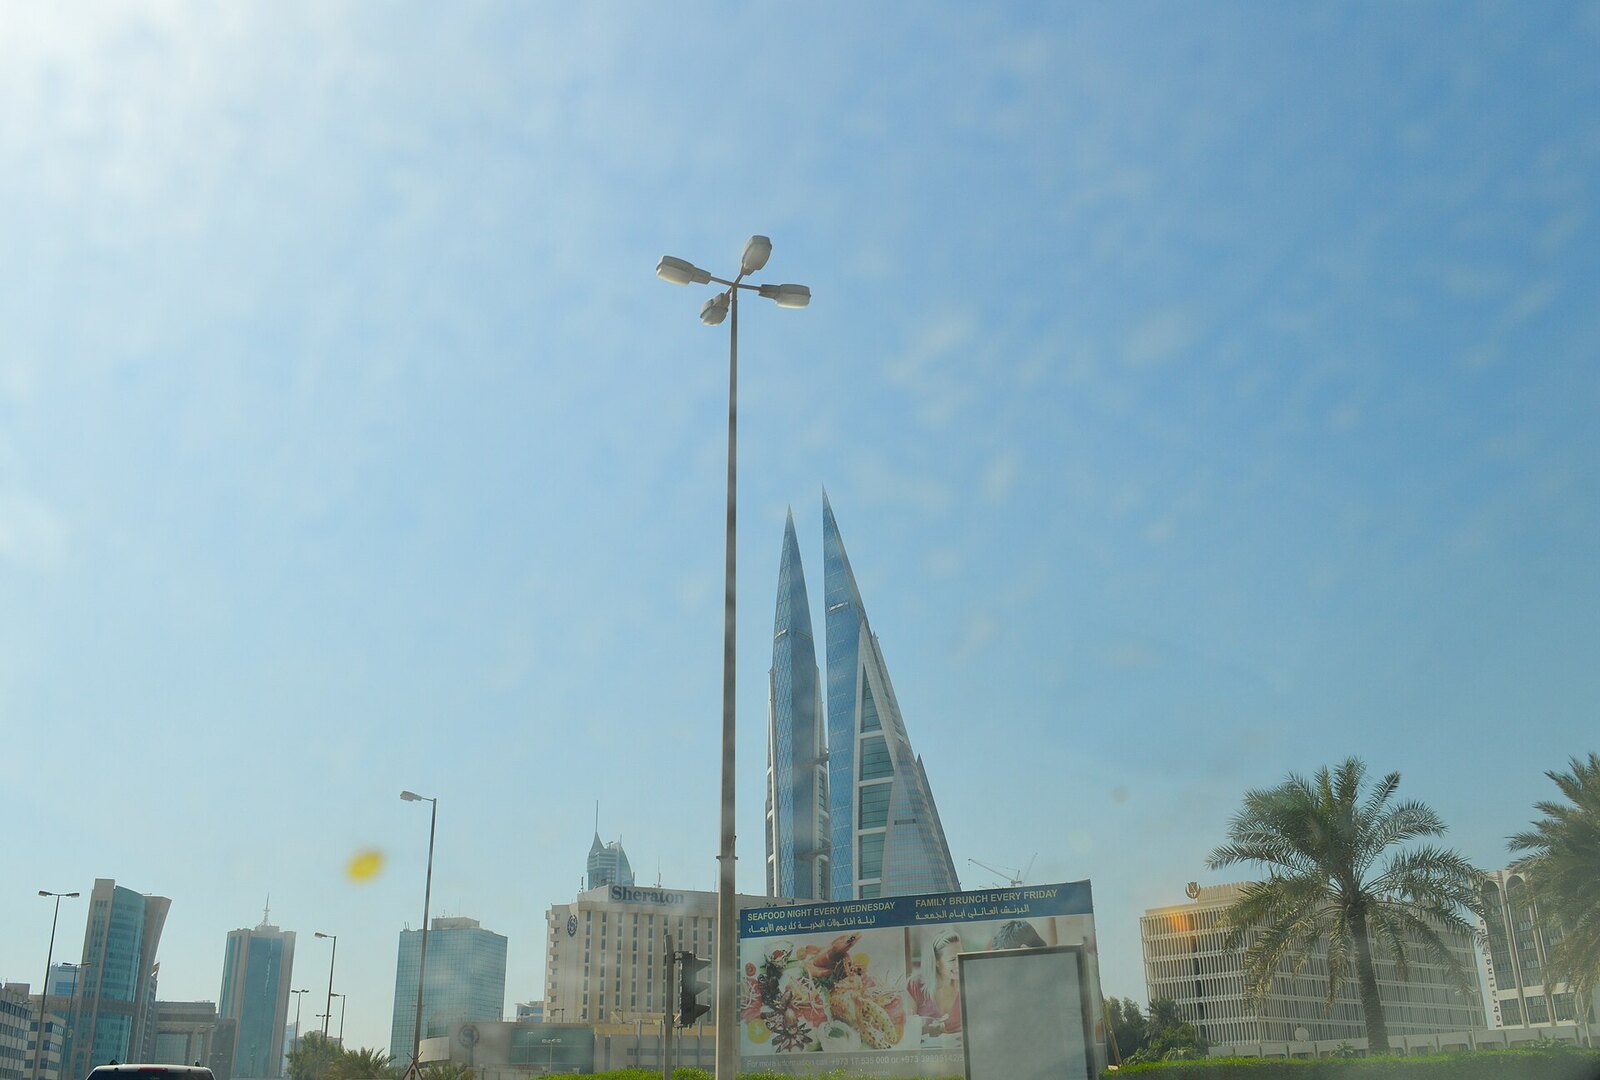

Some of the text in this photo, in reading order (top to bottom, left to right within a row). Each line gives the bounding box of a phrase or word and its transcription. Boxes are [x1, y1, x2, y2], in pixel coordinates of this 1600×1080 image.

[611, 885, 684, 904] Sheraton
[915, 889, 1058, 908] FAMILY BRUNCH EVERY FRIDAY
[747, 901, 896, 921] SEAFOOD NIGHT EVERY WEDNESDAY
[915, 910, 947, 920] الجمعة
[857, 915, 876, 926] ليلة
[875, 1055, 890, 1065] 000
[890, 1055, 900, 1064] or
[901, 1055, 919, 1064] +973
